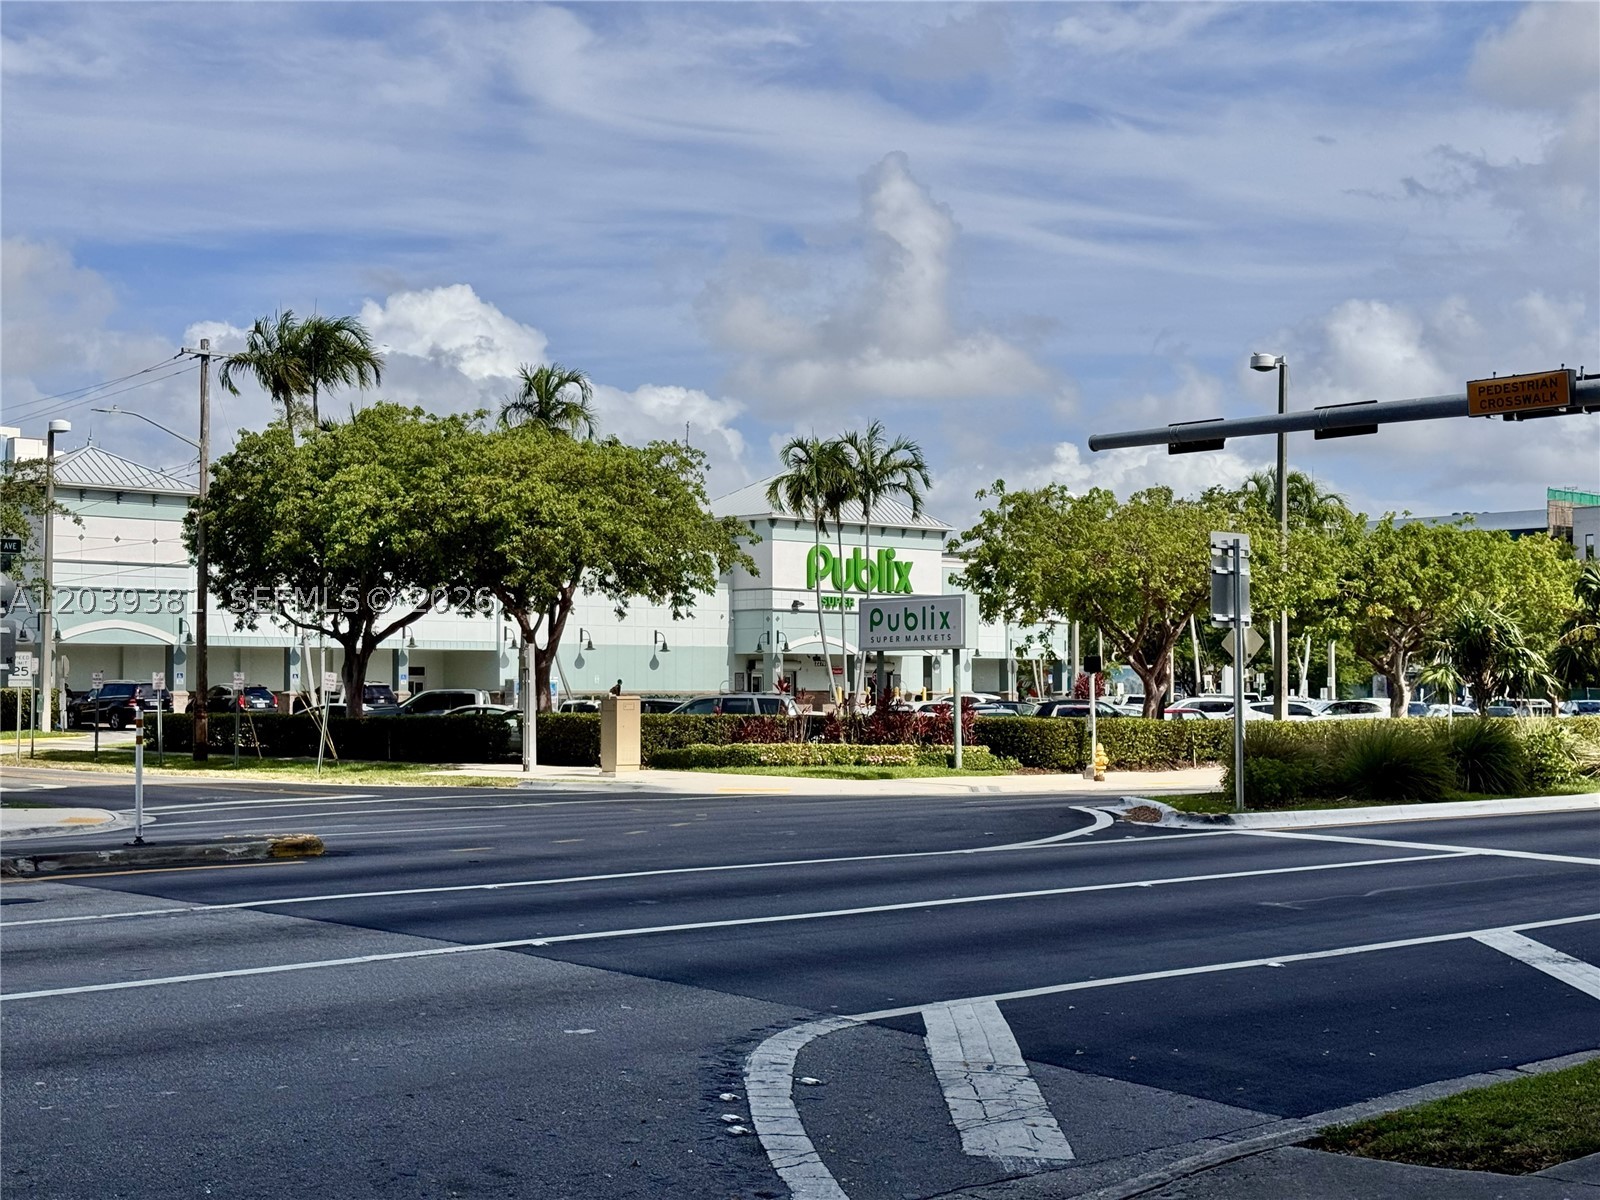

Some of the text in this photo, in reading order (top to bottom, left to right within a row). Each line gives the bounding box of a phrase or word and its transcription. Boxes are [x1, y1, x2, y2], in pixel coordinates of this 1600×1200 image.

[1478, 377, 1558, 397] PEDESTRIAN
[1480, 391, 1558, 410] CROSSWALK
[3, 542, 17, 550] AVE
[806, 544, 914, 595] Publix
[869, 604, 951, 633] Publix
[870, 633, 952, 644] SUPER MARKETS
[12, 666, 29, 677] 25
